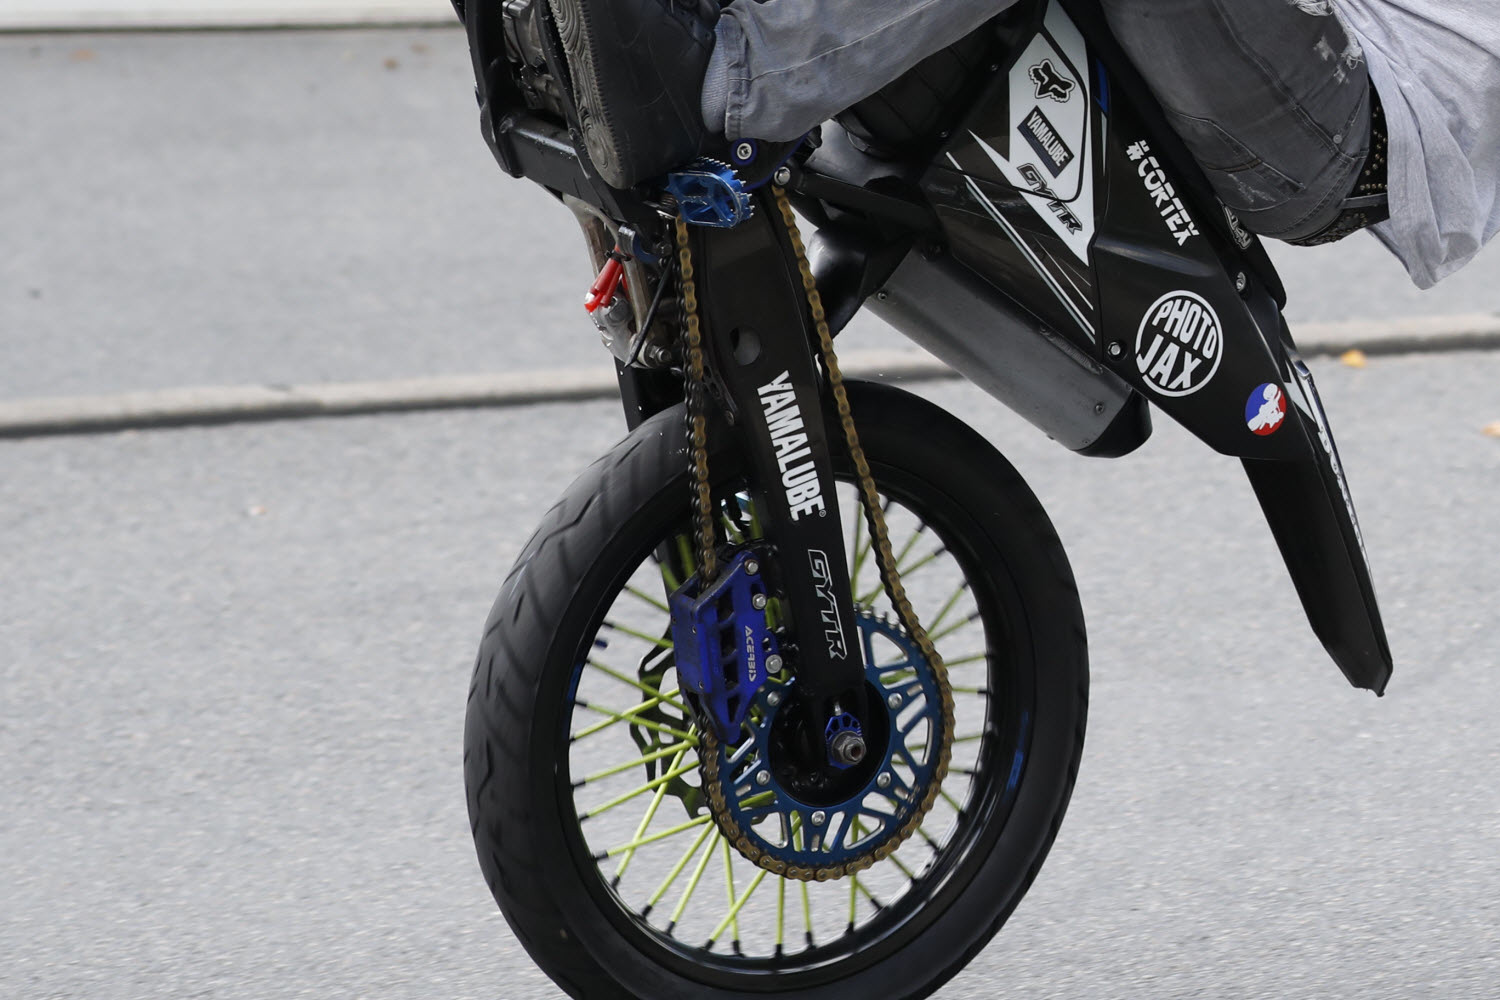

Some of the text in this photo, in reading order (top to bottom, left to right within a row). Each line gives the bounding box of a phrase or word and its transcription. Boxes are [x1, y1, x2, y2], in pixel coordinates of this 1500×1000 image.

[1027, 111, 1069, 167] YAMALUBE
[1017, 163, 1082, 235] GYTR
[1126, 140, 1200, 246] #CORTEX
[1136, 333, 1202, 389] JAX
[1152, 299, 1217, 359] PHOTO
[808, 549, 847, 660] GYTR
